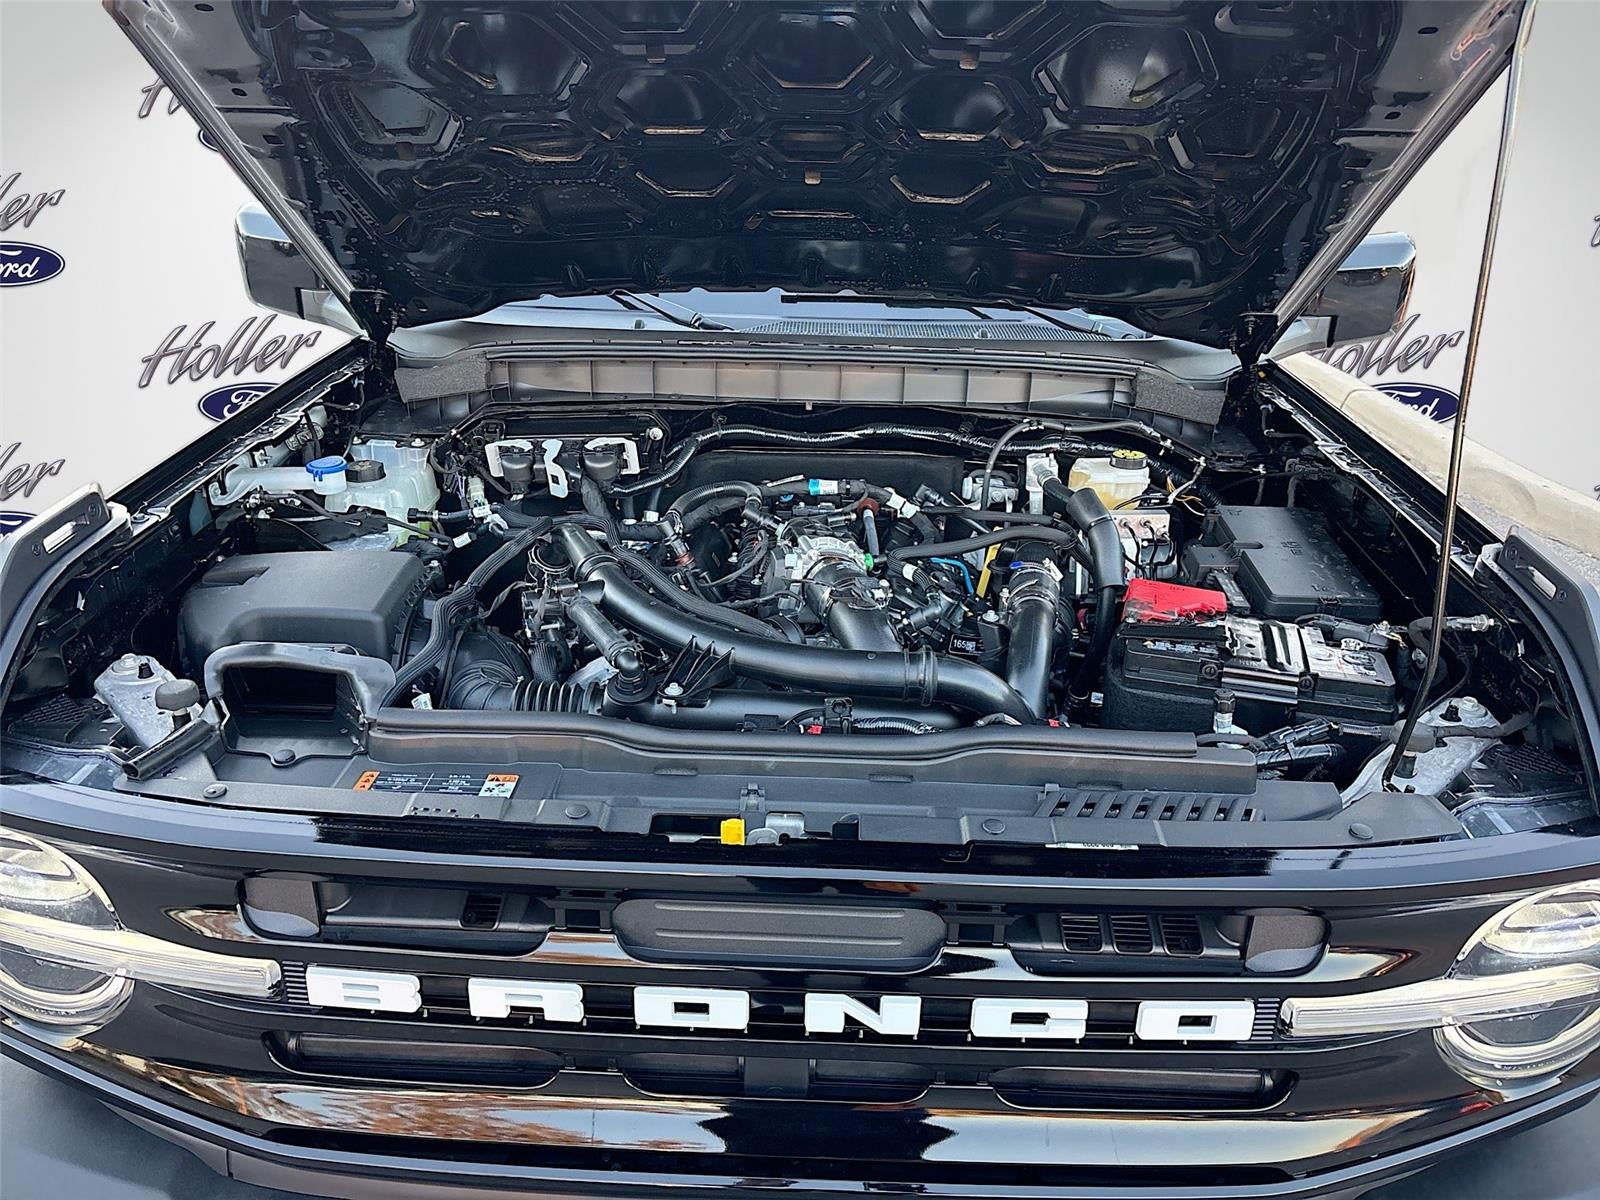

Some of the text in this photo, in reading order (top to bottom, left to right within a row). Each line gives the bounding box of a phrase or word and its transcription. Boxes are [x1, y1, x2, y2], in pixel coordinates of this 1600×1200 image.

[138, 313, 322, 389] Holler
[1308, 313, 1465, 378] oller
[306, 966, 1255, 1041] BRONCO
